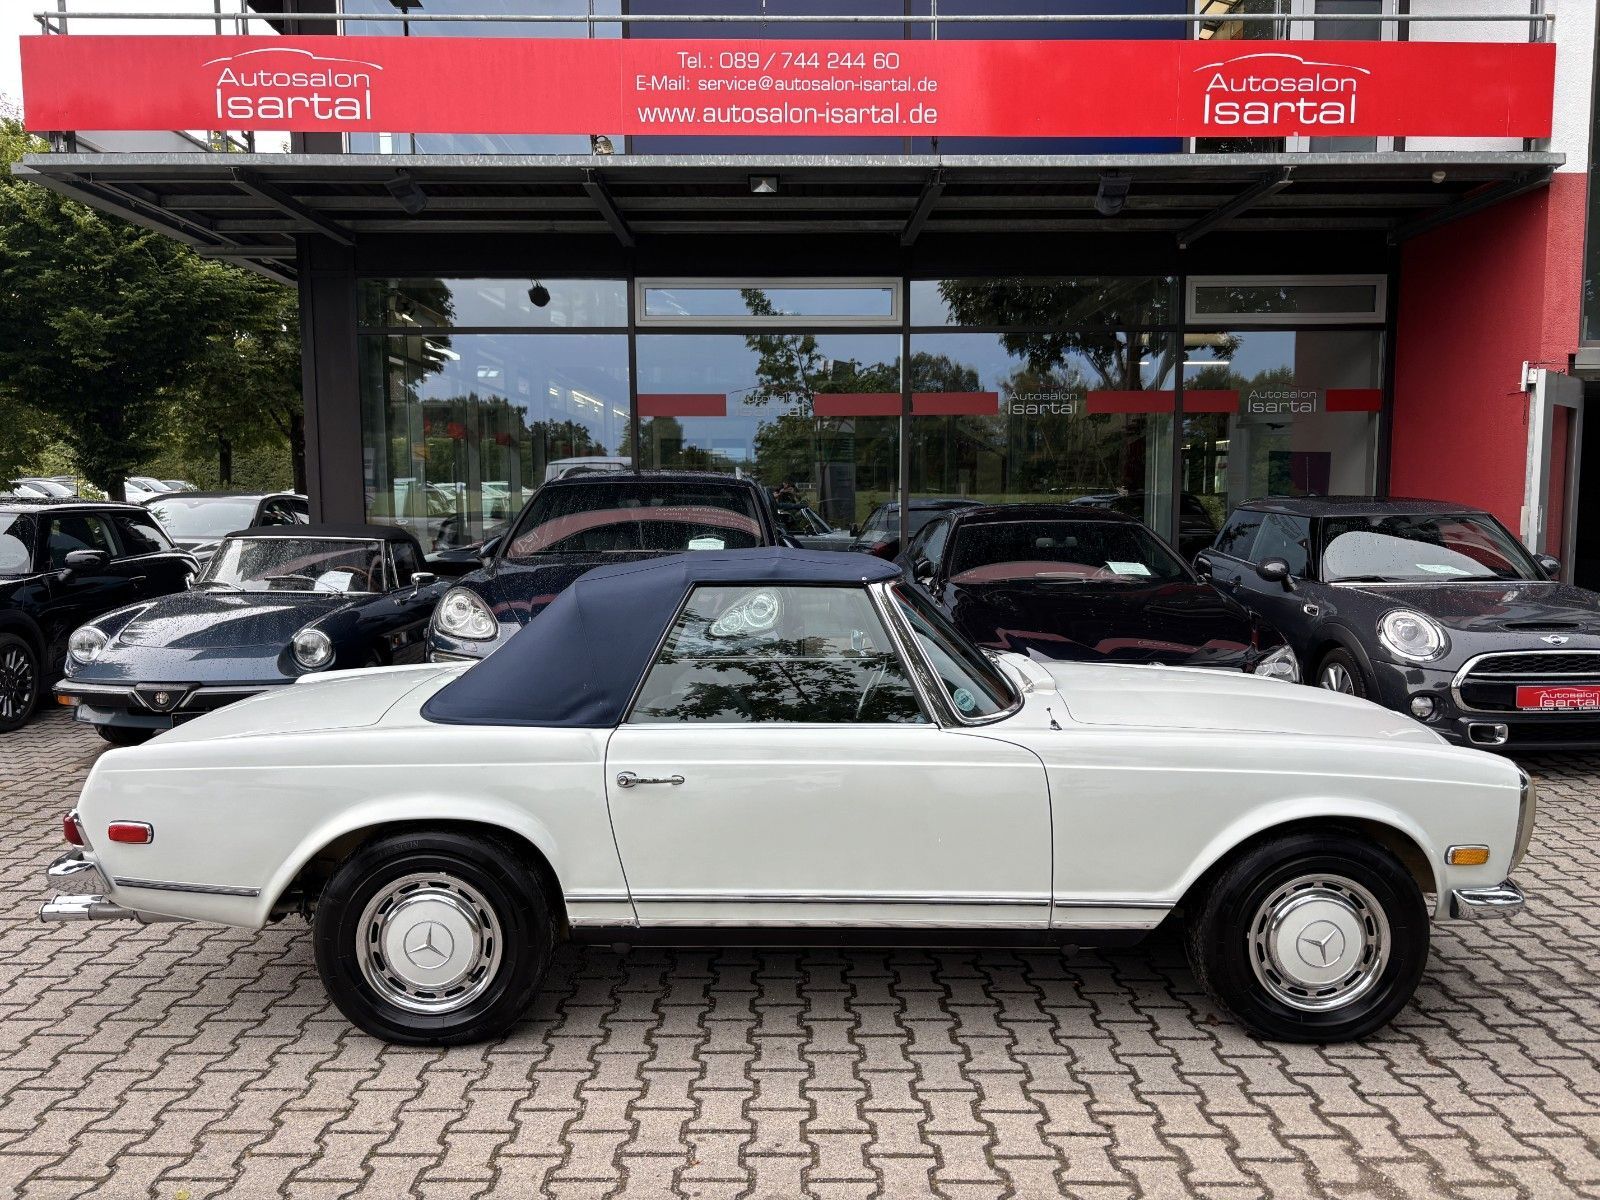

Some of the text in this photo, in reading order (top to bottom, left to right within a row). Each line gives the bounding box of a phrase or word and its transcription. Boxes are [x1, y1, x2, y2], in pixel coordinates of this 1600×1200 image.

[676, 52, 713, 69] Tel.:
[719, 52, 760, 69] 089
[781, 52, 820, 69] 744
[827, 52, 866, 69] 244
[873, 52, 900, 69] 60
[217, 67, 370, 88] Autosalon
[636, 75, 938, 92] E-Mail: service@autosalon-isartal.de
[1206, 73, 1356, 92] Autosalon
[216, 88, 371, 120] Isartal
[1203, 94, 1356, 125] Isartal
[637, 102, 938, 124] www.autosalon-isartal.de
[1009, 391, 1078, 400] Autosalon
[1249, 389, 1317, 398] Autosalon
[1007, 400, 1078, 415] Isartal
[1247, 398, 1317, 413] Isartal
